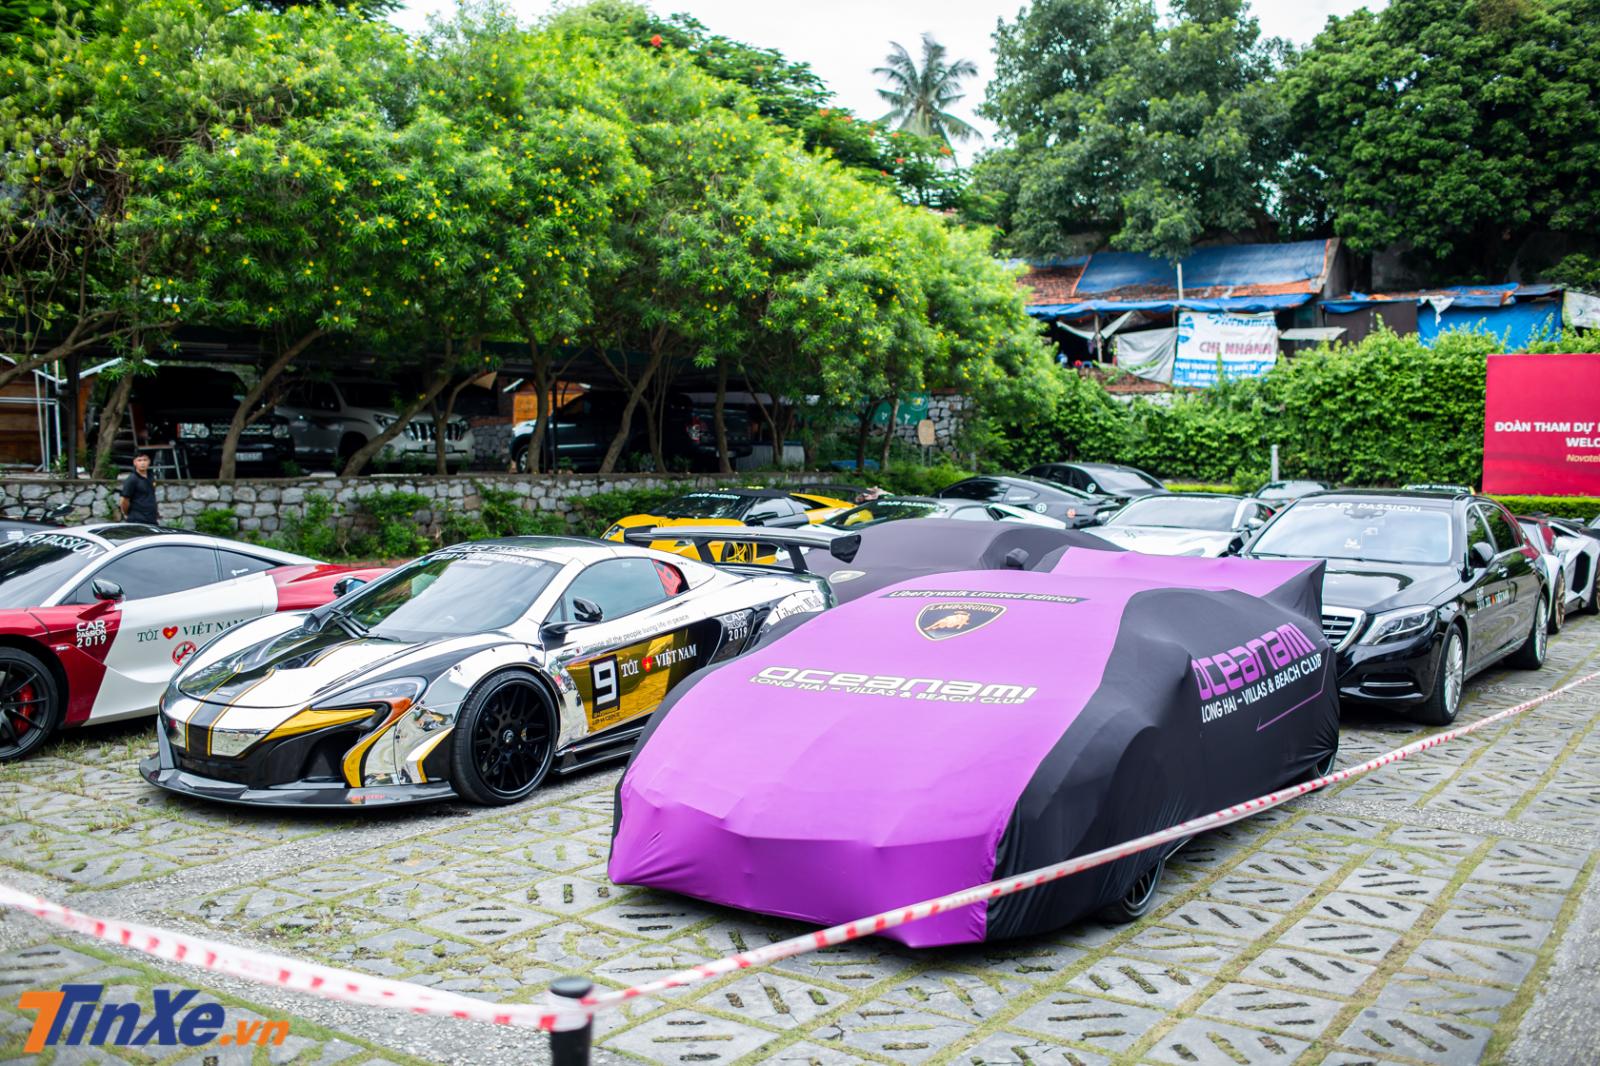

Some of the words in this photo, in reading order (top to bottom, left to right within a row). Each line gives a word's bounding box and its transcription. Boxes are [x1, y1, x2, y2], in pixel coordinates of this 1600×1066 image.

[1199, 341, 1221, 354] CHI
[1534, 421, 1571, 432] THAM
[1358, 503, 1421, 513] PASSION
[888, 590, 969, 598] Libertywalk
[970, 591, 1023, 599] Limited
[1026, 593, 1077, 603] Edition
[929, 603, 1000, 614] LAMBORGHINI
[723, 611, 746, 622] CAR
[76, 620, 106, 631] CAR
[623, 629, 642, 640] people
[673, 614, 690, 625] peace
[727, 619, 748, 630] PASSION
[76, 629, 107, 639] PASSION
[137, 629, 159, 643] TÔI
[183, 621, 213, 637] VIỆT
[728, 627, 747, 641] 2019
[76, 634, 107, 648] 2019
[621, 659, 640, 678] TÔI
[655, 648, 678, 668] VIỆT
[678, 643, 697, 662] NAM
[593, 659, 617, 706] 9
[1201, 700, 1223, 724] LONG
[1222, 695, 1238, 715] HAI
[1242, 681, 1268, 705] VILLAS
[1267, 678, 1275, 694] &
[1274, 663, 1301, 690] BEACH
[1300, 653, 1322, 675] CLUB
[749, 675, 797, 688] LONG
[798, 681, 827, 693] HAI
[844, 685, 897, 697] VILLAS
[899, 690, 913, 699] &
[916, 692, 977, 704] BEACH
[979, 694, 1025, 705] CLUB
